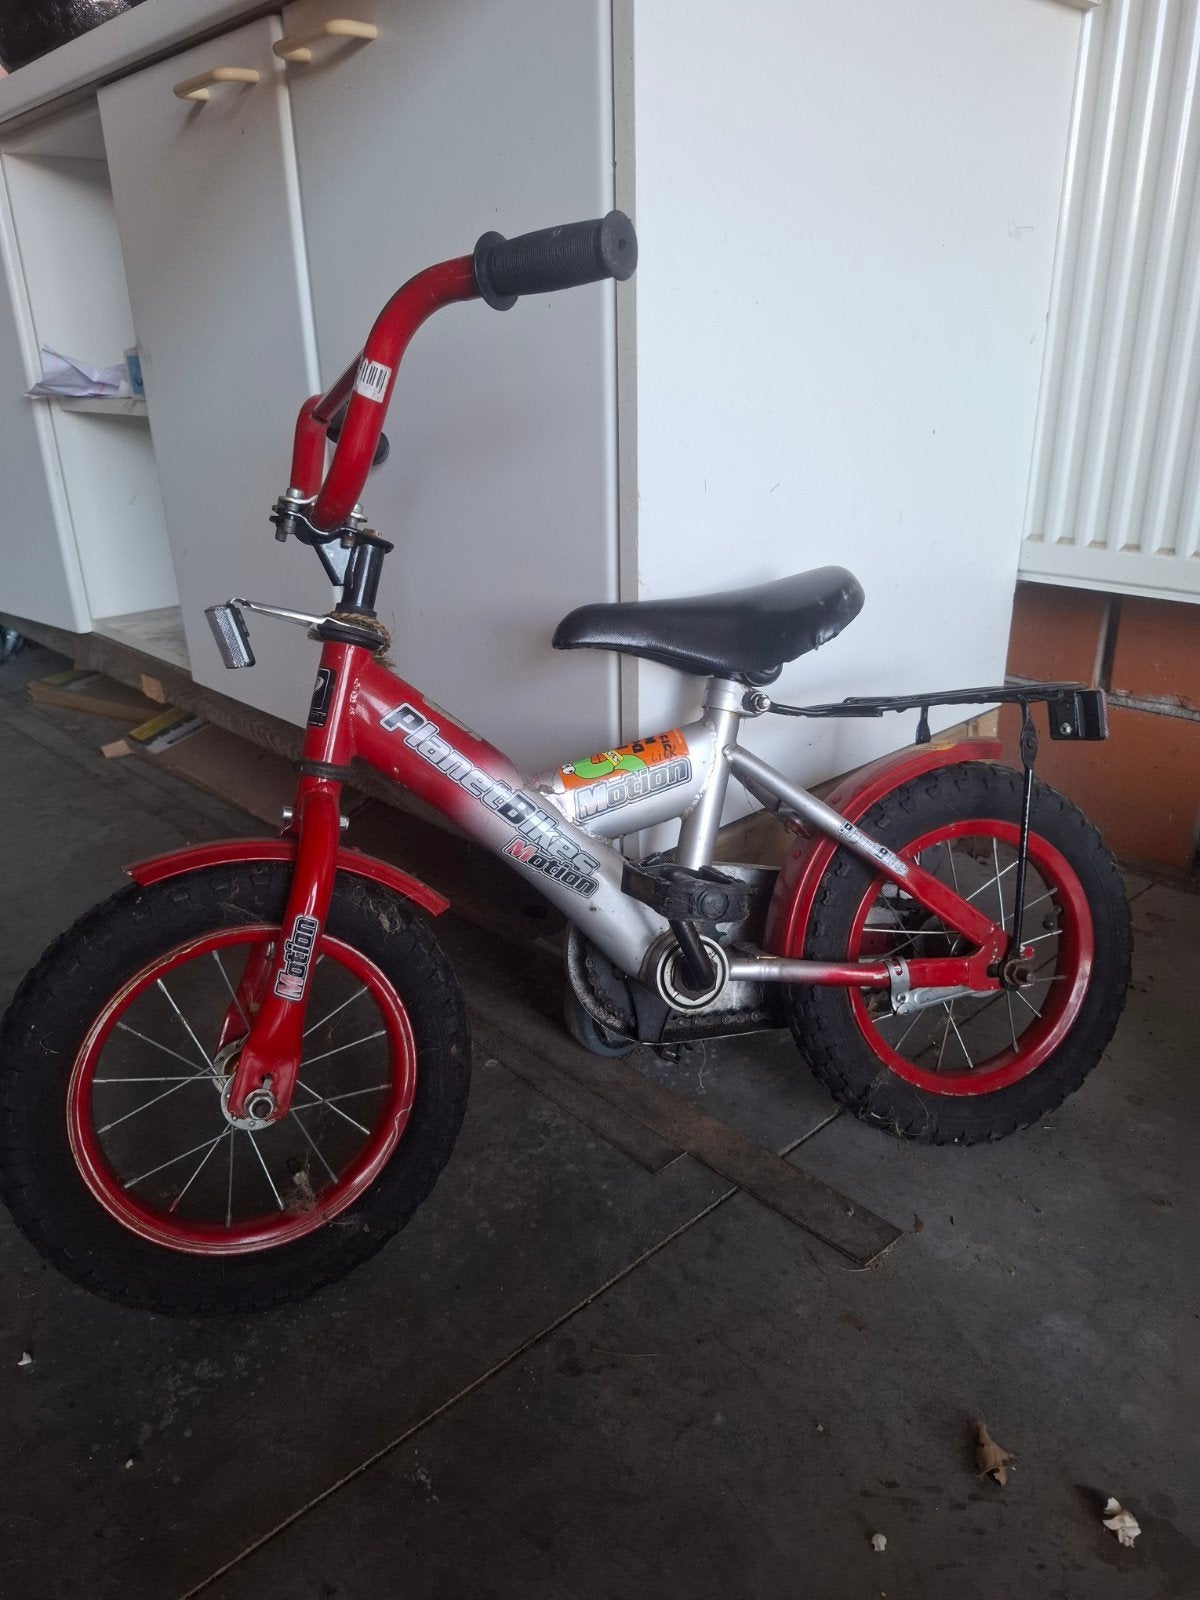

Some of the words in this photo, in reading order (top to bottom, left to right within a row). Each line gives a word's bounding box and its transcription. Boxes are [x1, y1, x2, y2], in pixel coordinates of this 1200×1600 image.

[574, 757, 692, 823] Motion
[502, 834, 600, 899] Motion
[273, 914, 319, 1002] Motion
